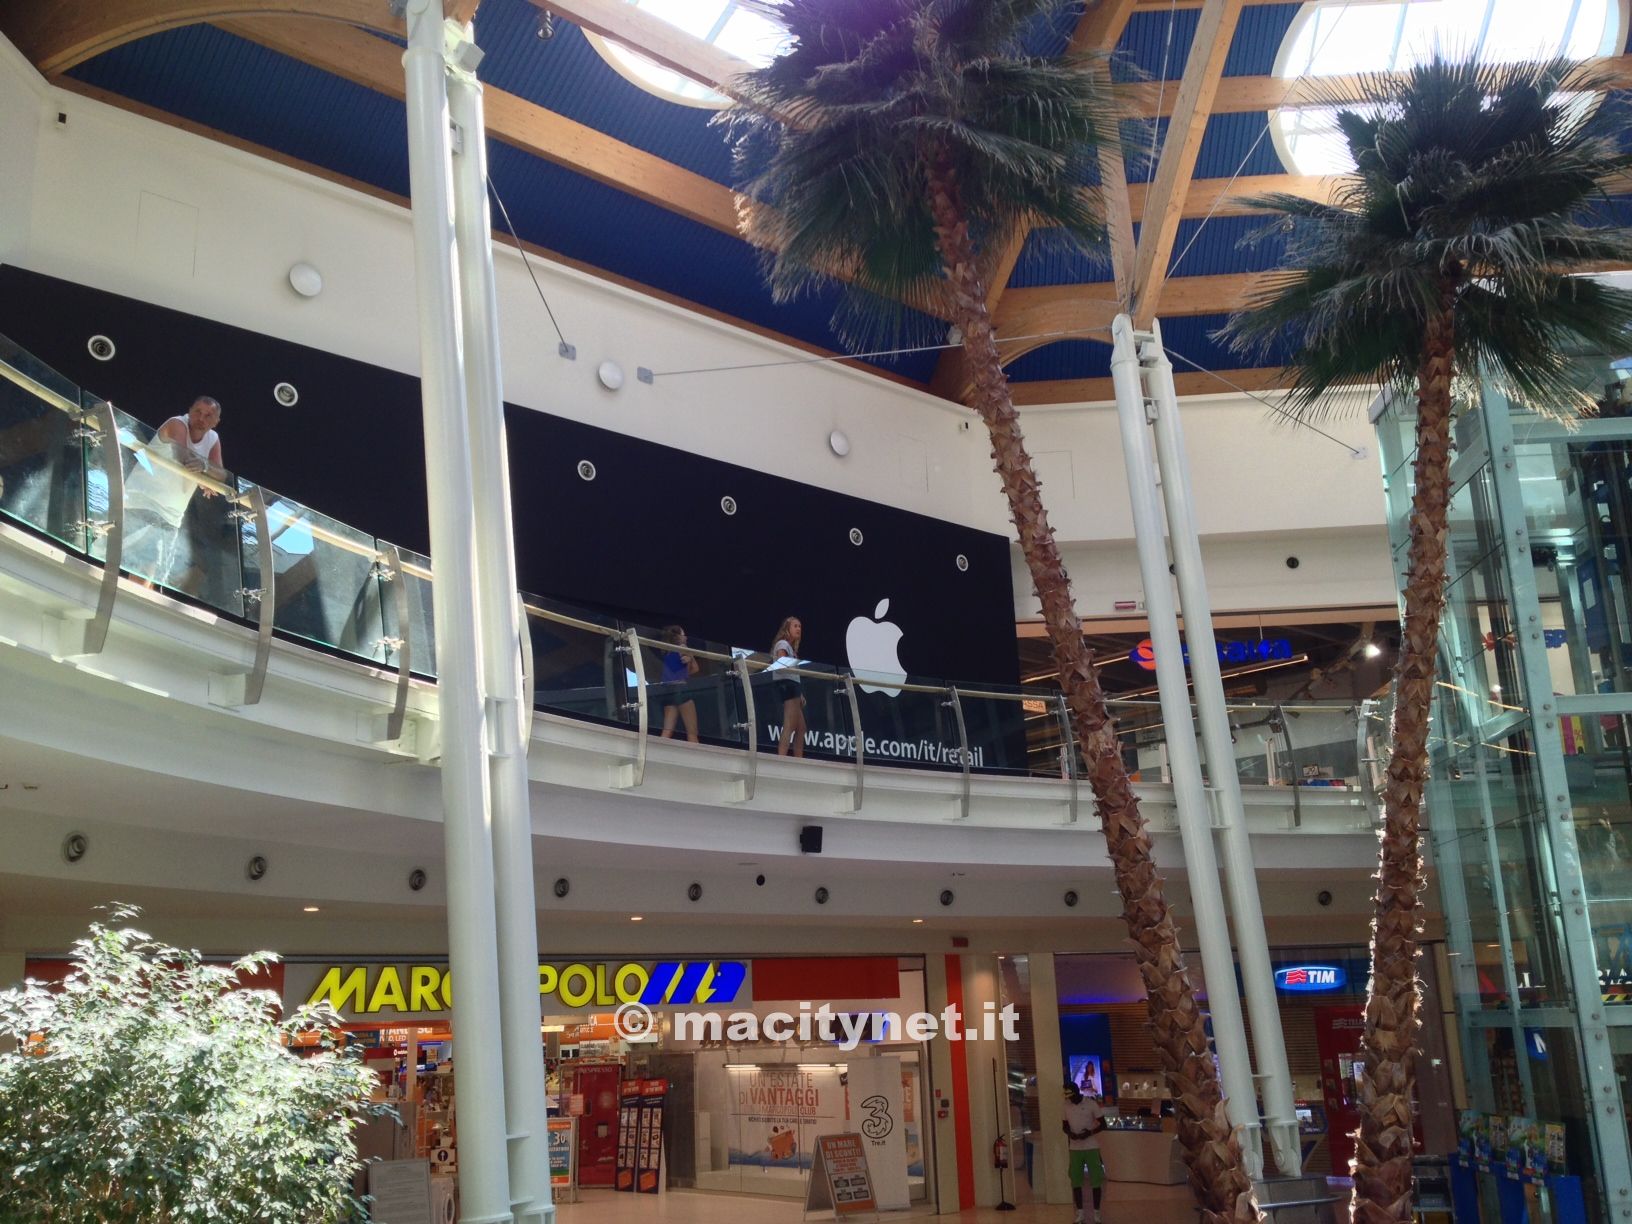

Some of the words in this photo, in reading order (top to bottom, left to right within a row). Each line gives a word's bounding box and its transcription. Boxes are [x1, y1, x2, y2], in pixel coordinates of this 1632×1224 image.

[1308, 970, 1335, 984] TIM
[306, 965, 451, 1013] MAR
[538, 962, 650, 1008] POLO
[749, 1071, 813, 1089] UN'ESTATE
[749, 1087, 820, 1107] VANTAGGI
